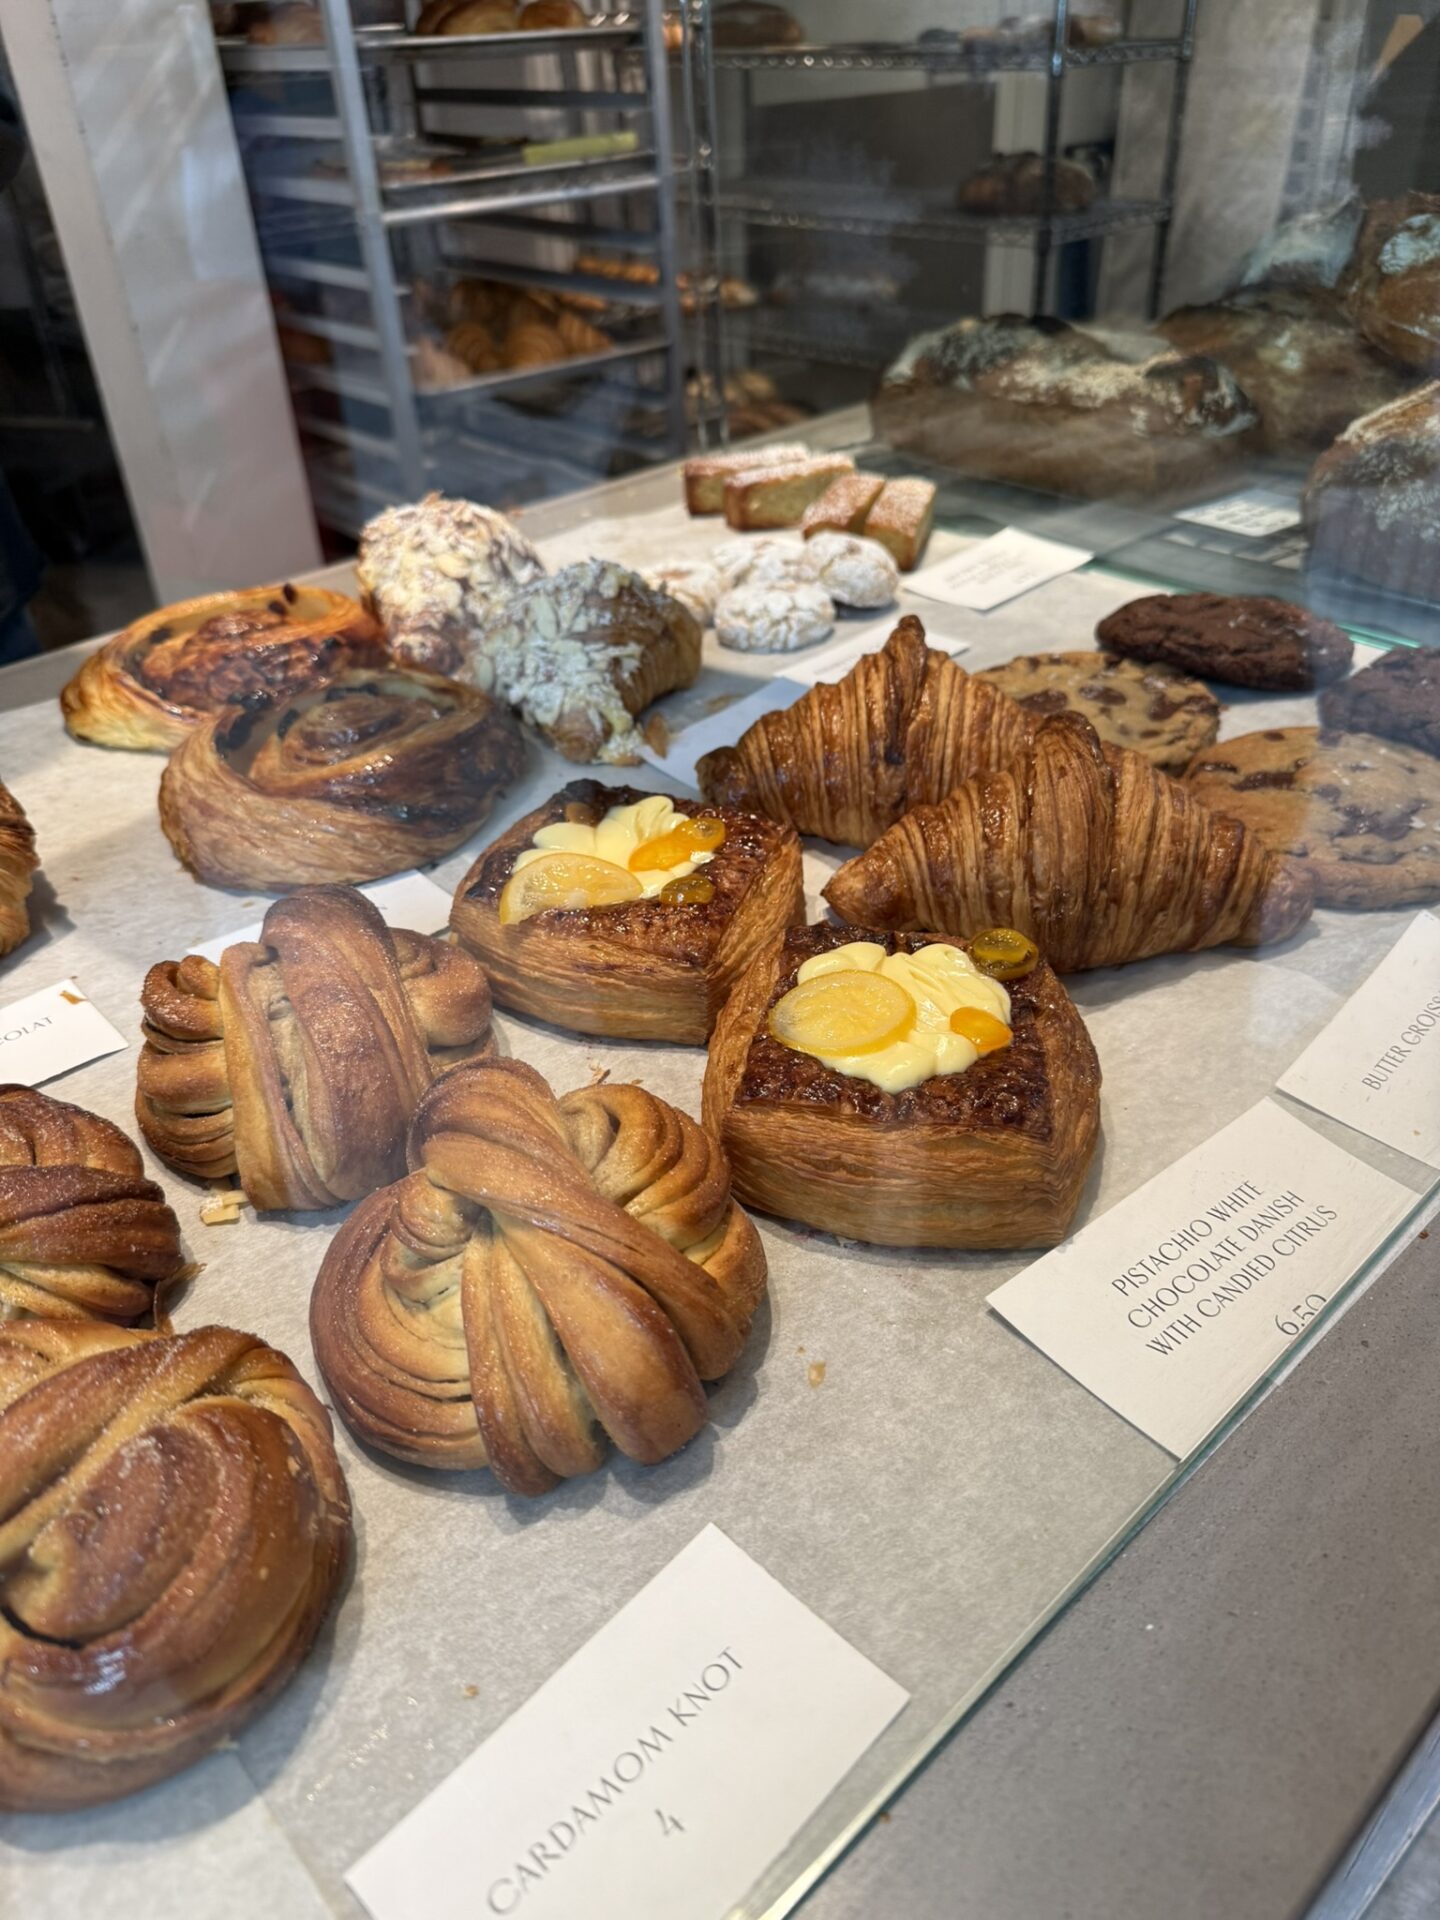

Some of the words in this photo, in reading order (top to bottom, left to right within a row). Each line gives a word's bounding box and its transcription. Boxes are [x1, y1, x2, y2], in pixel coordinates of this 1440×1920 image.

[0, 1016, 53, 1046] OLAT
[1362, 1045, 1412, 1090] BUTTER
[1111, 1219, 1213, 1297] PISTACHIO
[1206, 1180, 1264, 1222] WHITE
[1127, 1236, 1246, 1328] CHOCOLATE
[1237, 1190, 1305, 1242] DANISH
[1145, 1313, 1203, 1356] WITH
[1196, 1254, 1276, 1318] CANDIED
[1271, 1204, 1338, 1257] CITRUS
[1275, 1294, 1327, 1336] 6.50
[487, 1725, 674, 1916] CARDAMOM
[666, 1646, 743, 1727] KNOT
[655, 1808, 686, 1838] 4
